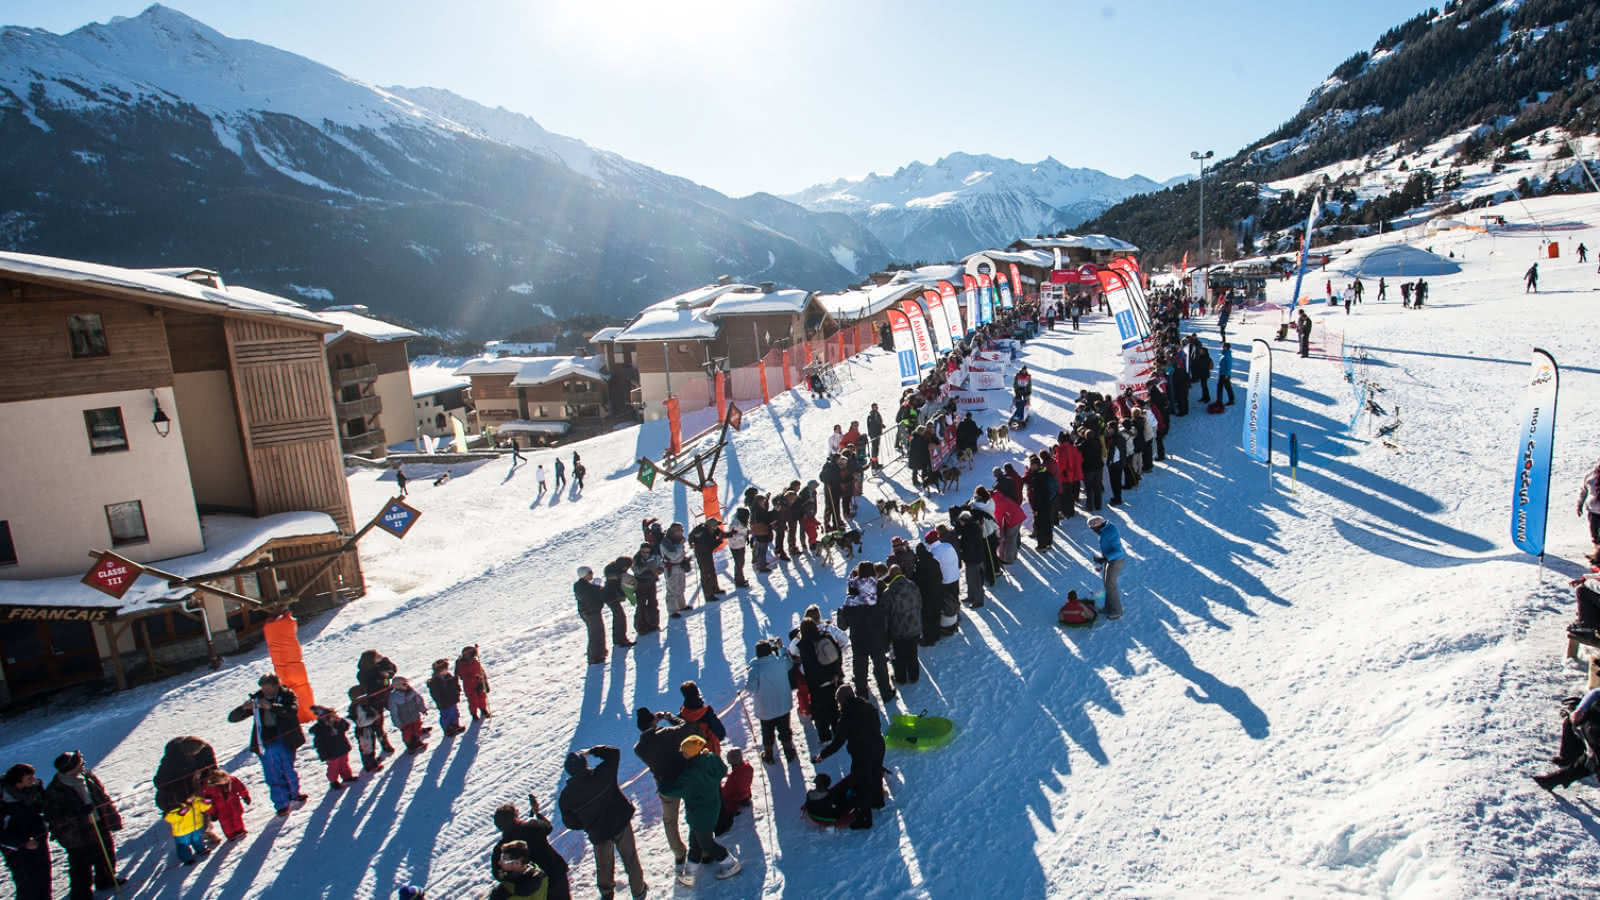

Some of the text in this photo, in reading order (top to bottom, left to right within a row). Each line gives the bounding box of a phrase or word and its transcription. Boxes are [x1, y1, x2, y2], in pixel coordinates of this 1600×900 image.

[385, 511, 408, 521] CLASSE
[98, 566, 128, 578] CLASSE
[107, 577, 123, 586] III
[7, 607, 109, 621] FRANCAIS
